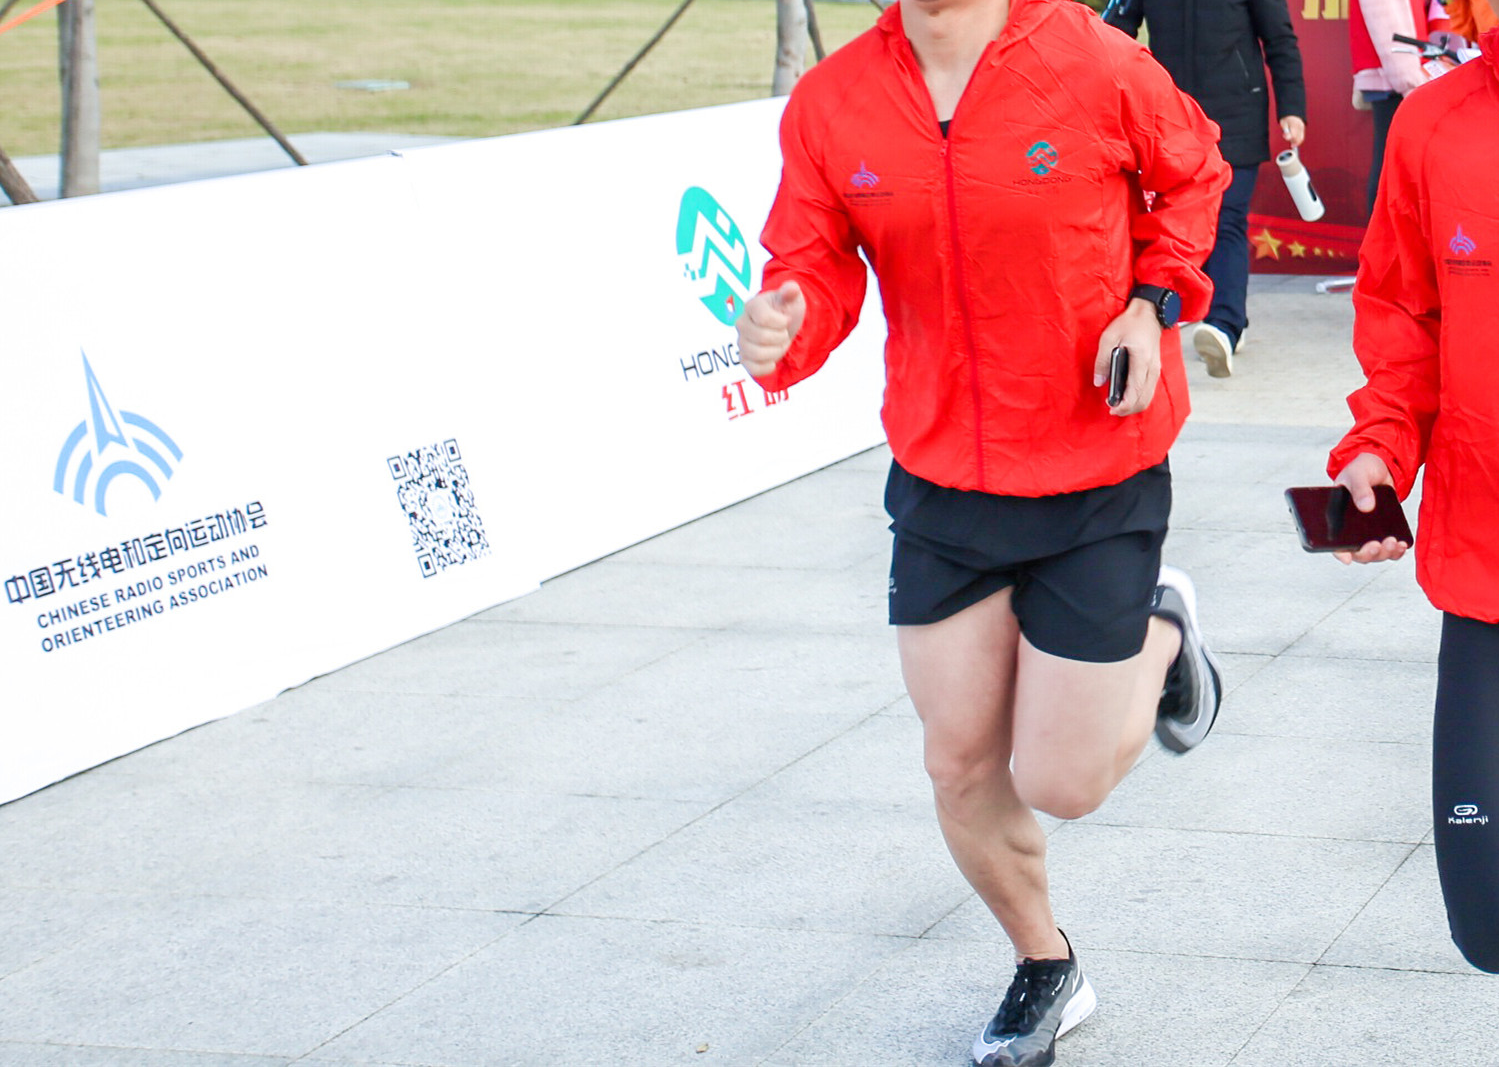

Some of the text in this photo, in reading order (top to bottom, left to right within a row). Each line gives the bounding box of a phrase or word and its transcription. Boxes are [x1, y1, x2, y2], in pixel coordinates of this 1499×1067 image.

[4, 501, 268, 605] 中国无线电和定向运动协会
[37, 544, 261, 629] CHINESE RADIO SPORTS AND
[41, 564, 269, 653] ORIENTEERING ASSOCIATION
[1448, 814, 1489, 826] Kalenji
